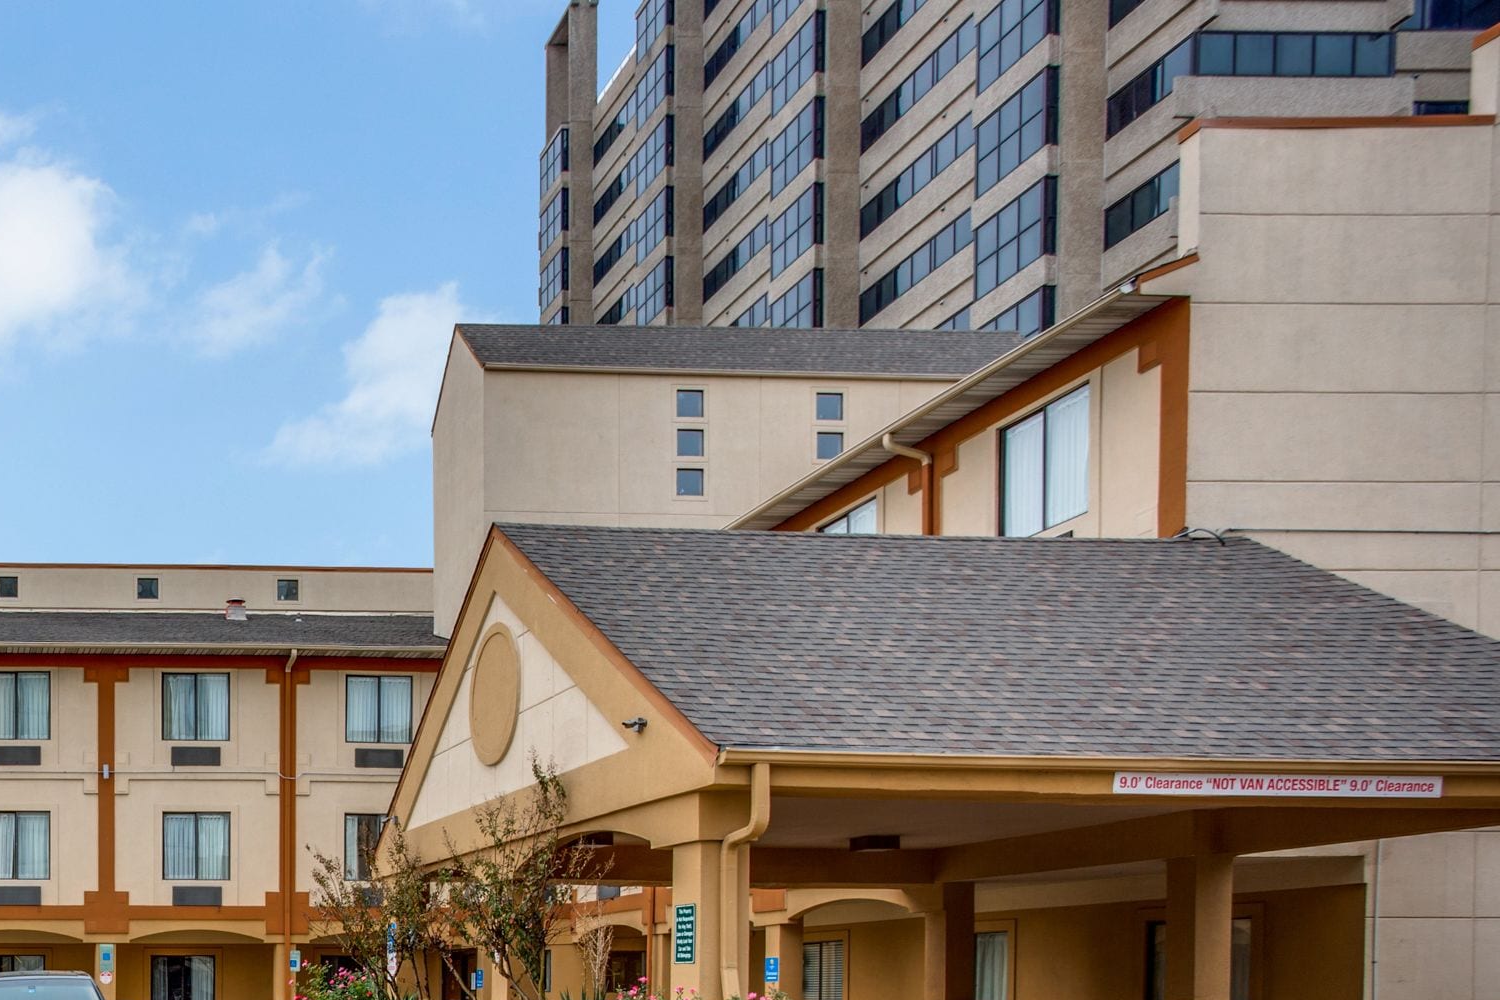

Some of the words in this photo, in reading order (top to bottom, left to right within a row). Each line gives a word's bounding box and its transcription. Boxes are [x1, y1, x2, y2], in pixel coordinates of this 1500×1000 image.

[1145, 776, 1203, 789] Clearance
[1240, 778, 1263, 790] VAN
[1376, 779, 1434, 793] Clearance
